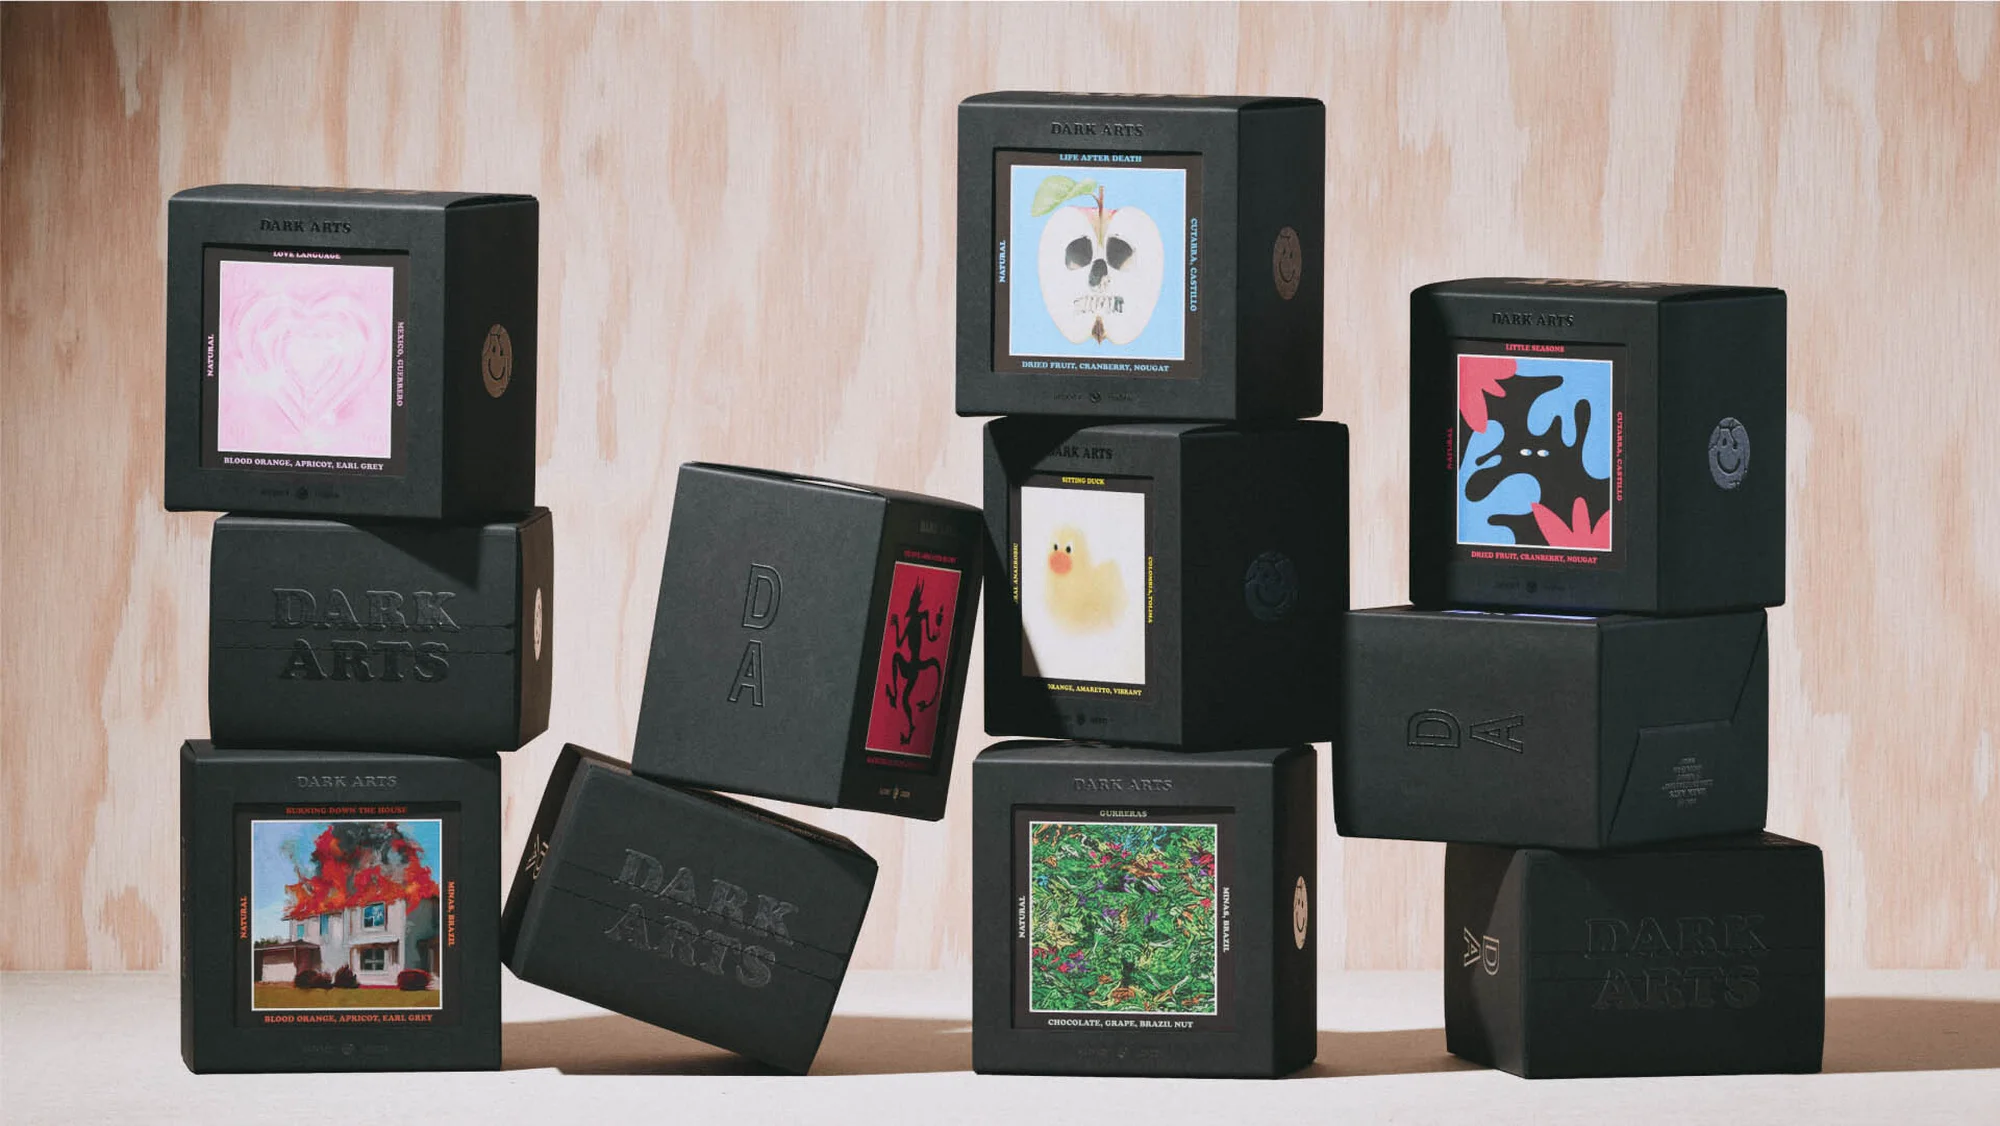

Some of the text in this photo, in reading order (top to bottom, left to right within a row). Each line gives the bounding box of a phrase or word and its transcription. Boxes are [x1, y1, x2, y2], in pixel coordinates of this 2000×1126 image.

[1051, 122, 1144, 137] DARK ARTS
[1059, 153, 1142, 163] LIFE AFTER DEATH
[260, 220, 351, 234] DARK ARTS
[1190, 267, 1198, 312] CASTILLO
[1492, 312, 1574, 327] DARK ARTS
[1505, 343, 1565, 353] LITTLE SEASONS
[207, 334, 215, 377] NATURAL
[396, 321, 404, 407] MEXICO, GUERRERO
[1021, 360, 1170, 372] DRIED FRUIT, CRANBERRY, NOUGAT
[1083, 447, 1114, 460] ARTS
[223, 457, 252, 465] BLOOD
[254, 458, 293, 468] ORANGE,
[295, 460, 334, 470] APRICOT,
[360, 463, 384, 471] GREY
[1061, 476, 1105, 486] SITTING DUCK
[1471, 551, 1598, 564] DRIED FRUIT, CRANBERRY, NOUGAT
[271, 588, 460, 633] DARK
[279, 638, 451, 683] ARTS
[1075, 685, 1113, 695] AMARETTO,
[1113, 687, 1143, 696] VIBRANT
[297, 776, 398, 788] DARK ARTS
[1074, 778, 1174, 792] DARK ARTS
[358, 806, 376, 814] THE
[377, 806, 407, 814] HOUSE
[610, 848, 800, 945] DARK
[1222, 887, 1230, 918] MINAS,
[240, 895, 248, 939] NATURAL
[1018, 895, 1026, 939] NATURAL
[1584, 914, 1771, 960] DARK
[603, 903, 776, 988] ARTS
[1592, 965, 1761, 1010] ARTS
[264, 1014, 433, 1024] BLOOD ORANGE, APRICOT, EARL GREY
[1048, 1019, 1194, 1029] CHOCOLATE, GRAPE, BRAZIL NUT
